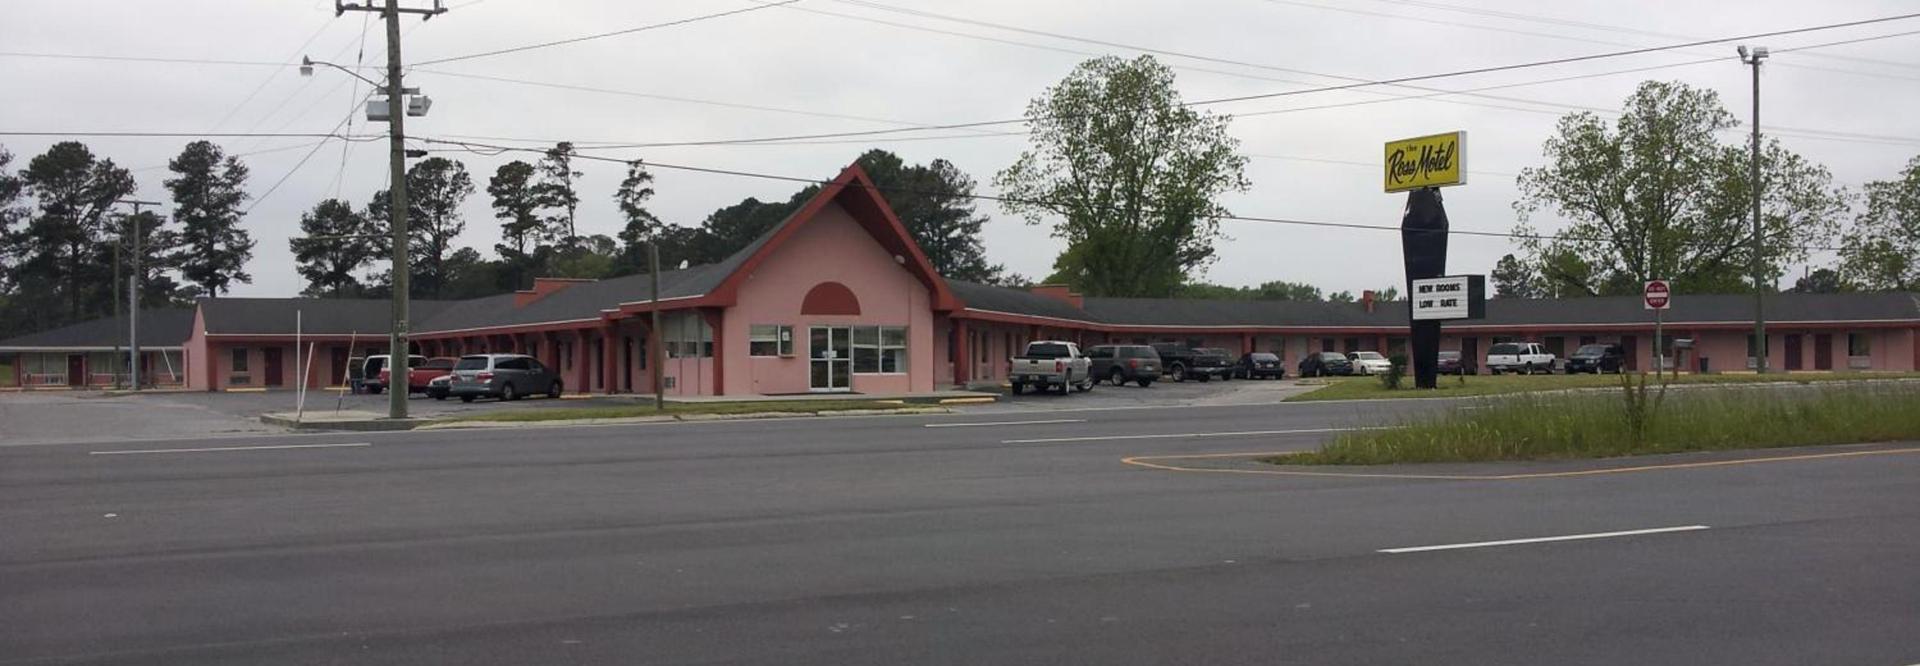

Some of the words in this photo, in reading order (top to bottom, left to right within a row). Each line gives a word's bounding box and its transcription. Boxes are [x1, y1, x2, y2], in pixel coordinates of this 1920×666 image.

[1388, 148, 1416, 185] Ross
[1409, 140, 1454, 182] Motel
[1419, 284, 1433, 293] NEW
[1436, 283, 1460, 292] ROOMS
[1419, 300, 1433, 308] LOW
[1440, 299, 1458, 308] RATE
